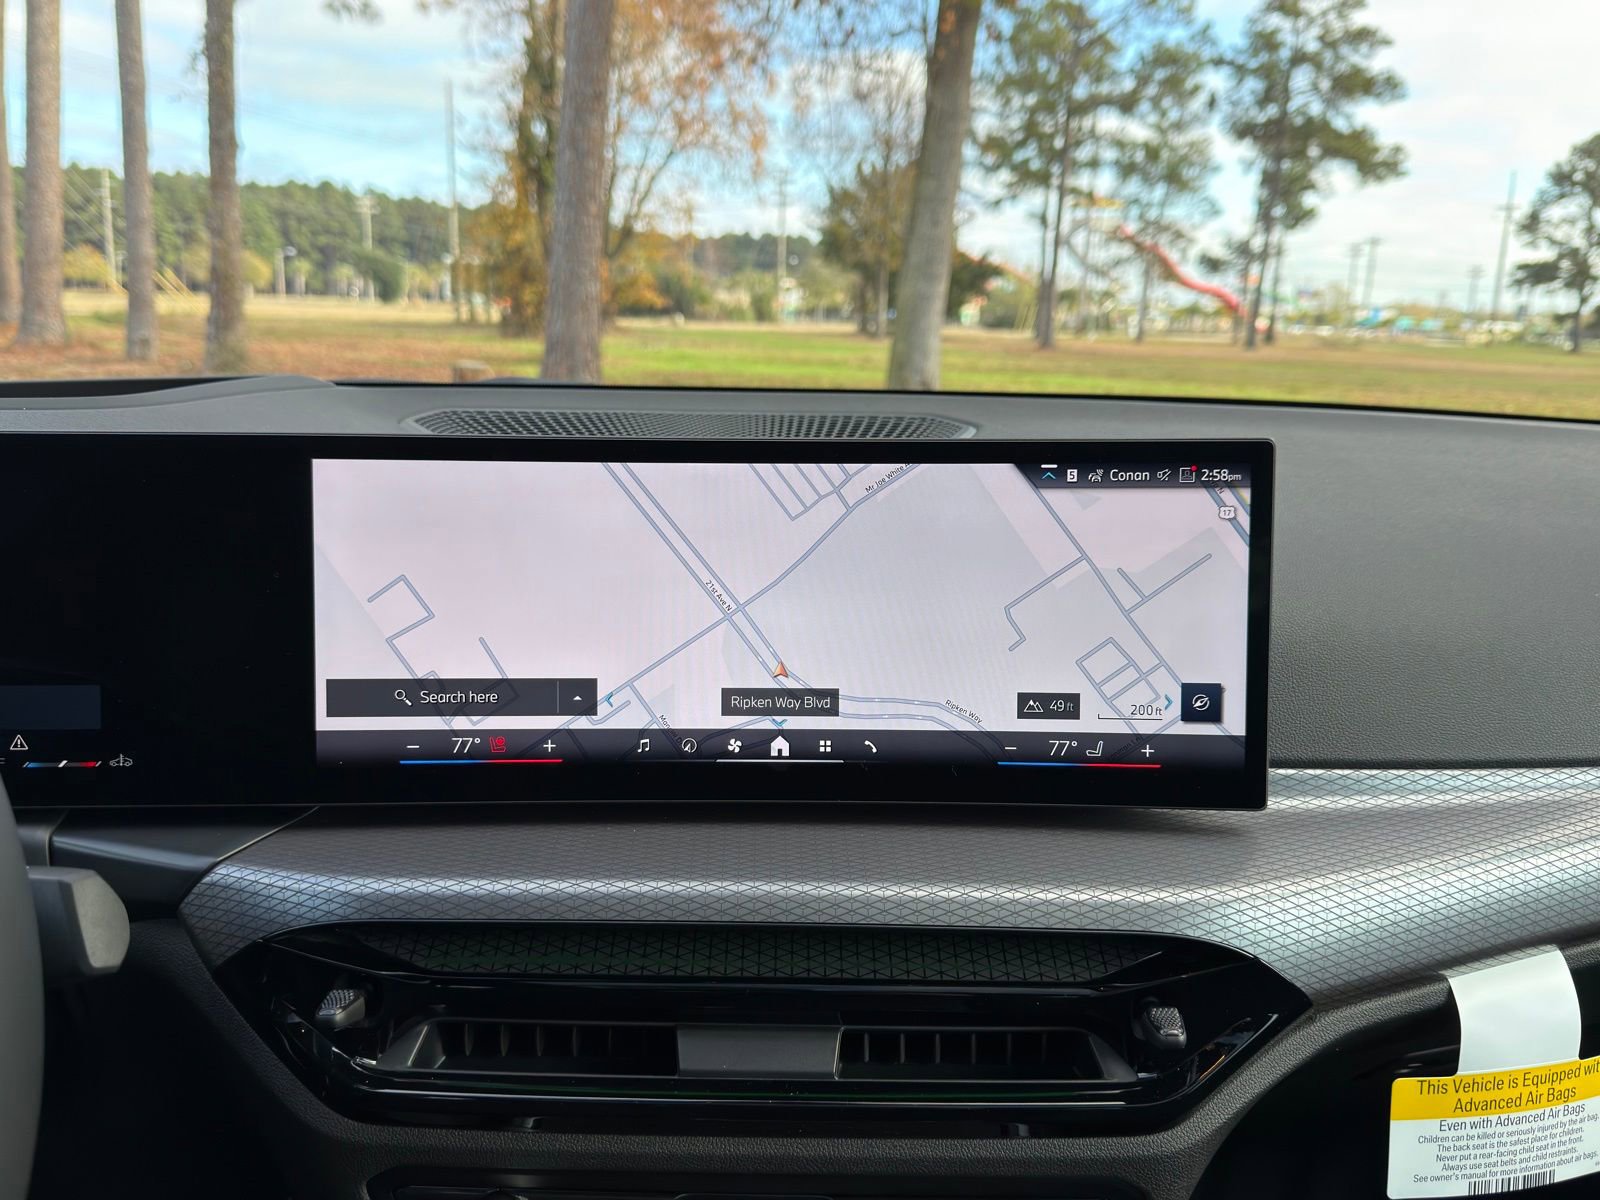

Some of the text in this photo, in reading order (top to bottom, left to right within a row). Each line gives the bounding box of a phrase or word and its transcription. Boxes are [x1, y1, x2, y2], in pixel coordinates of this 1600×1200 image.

[865, 465, 904, 493] Mr Joe White
[1110, 469, 1150, 481] Conan
[1201, 469, 1242, 482] 2:58pm
[1223, 509, 1231, 517] 17
[706, 579, 733, 612] 21st Ave N
[420, 690, 498, 703] Search here
[731, 696, 831, 710] Ripken Way Blvd
[1049, 700, 1074, 712] 49 ft
[945, 699, 983, 724] Ripken Way
[1130, 704, 1162, 716] 200 ft
[451, 737, 481, 753] 77°
[1049, 740, 1078, 756] 77°
[1417, 1059, 1600, 1095] This Vehicle is Equipped wit
[1454, 1086, 1576, 1113] Advanced Air Bags
[1418, 1134, 1450, 1144] Children
[1466, 1133, 1476, 1141] be
[1477, 1131, 1497, 1140] killed
[1506, 1126, 1536, 1137] seriously
[1536, 1121, 1559, 1133] injured
[1560, 1120, 1568, 1129] by
[1568, 1116, 1578, 1125] the
[1579, 1114, 1587, 1123] air
[1440, 1103, 1586, 1132] Even with Advanced Air Bags
[1436, 1153, 1458, 1162] Never
[1459, 1152, 1472, 1162] put
[1478, 1147, 1518, 1160] rear-facing
[1518, 1145, 1535, 1155] child
[1535, 1143, 1549, 1152] seat
[1550, 1141, 1557, 1149] in
[1557, 1139, 1567, 1148] the
[1568, 1135, 1584, 1145] front.
[1438, 1126, 1585, 1152] The back seat is the safest place for children.
[1413, 1174, 1428, 1183] See
[1430, 1172, 1459, 1182] owner's
[1461, 1169, 1488, 1180] manual
[1489, 1168, 1499, 1177] for
[1500, 1168, 1517, 1177] more
[1519, 1160, 1556, 1174] information
[1556, 1156, 1574, 1167] about
[1574, 1153, 1583, 1162] air
[1441, 1162, 1467, 1173] Always
[1483, 1159, 1499, 1168] seat
[1500, 1157, 1517, 1167] belts
[1518, 1154, 1531, 1164] and
[1532, 1152, 1548, 1162] child
[1548, 1146, 1579, 1159] restraints.
